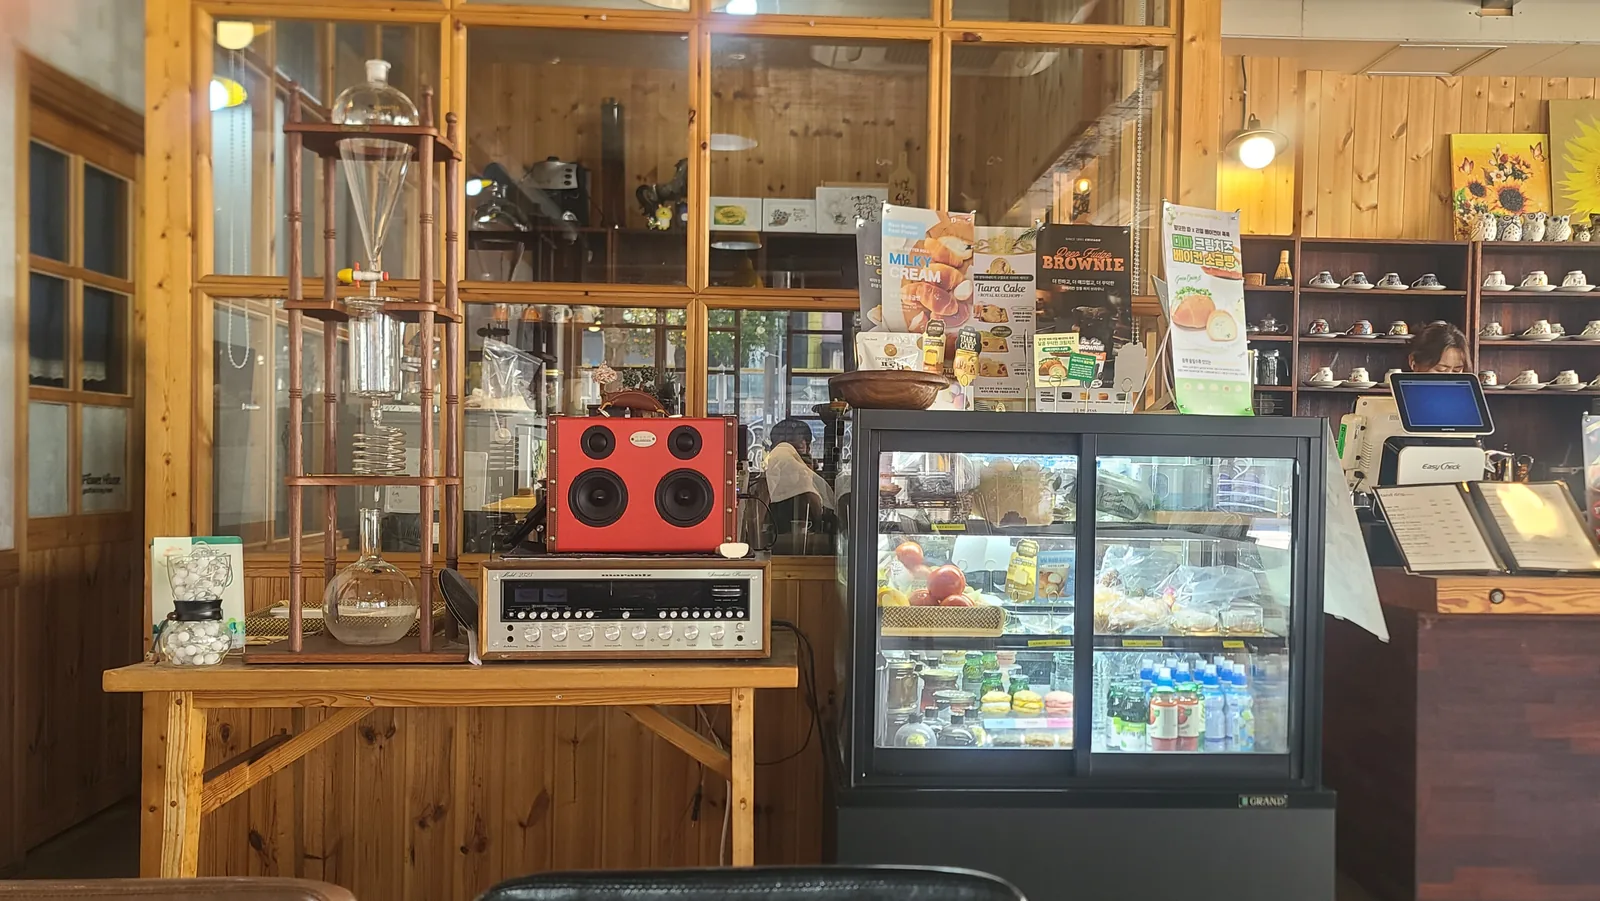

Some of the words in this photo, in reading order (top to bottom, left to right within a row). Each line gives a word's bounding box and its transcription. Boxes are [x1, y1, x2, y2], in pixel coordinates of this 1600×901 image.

[1172, 234, 1193, 249] 대파
[1194, 236, 1234, 255] 크림치즈
[889, 253, 931, 268] MILKY
[1042, 255, 1125, 272] BROWNIE
[1172, 248, 1204, 265] 베이컨
[1204, 251, 1236, 269] 소금빵
[890, 266, 941, 283] CREAM
[975, 283, 1001, 292] Tiara
[1003, 283, 1026, 293] Cake
[960, 335, 977, 345] TIARA
[960, 341, 976, 351] CAKE
[1249, 796, 1285, 807] GRAND
